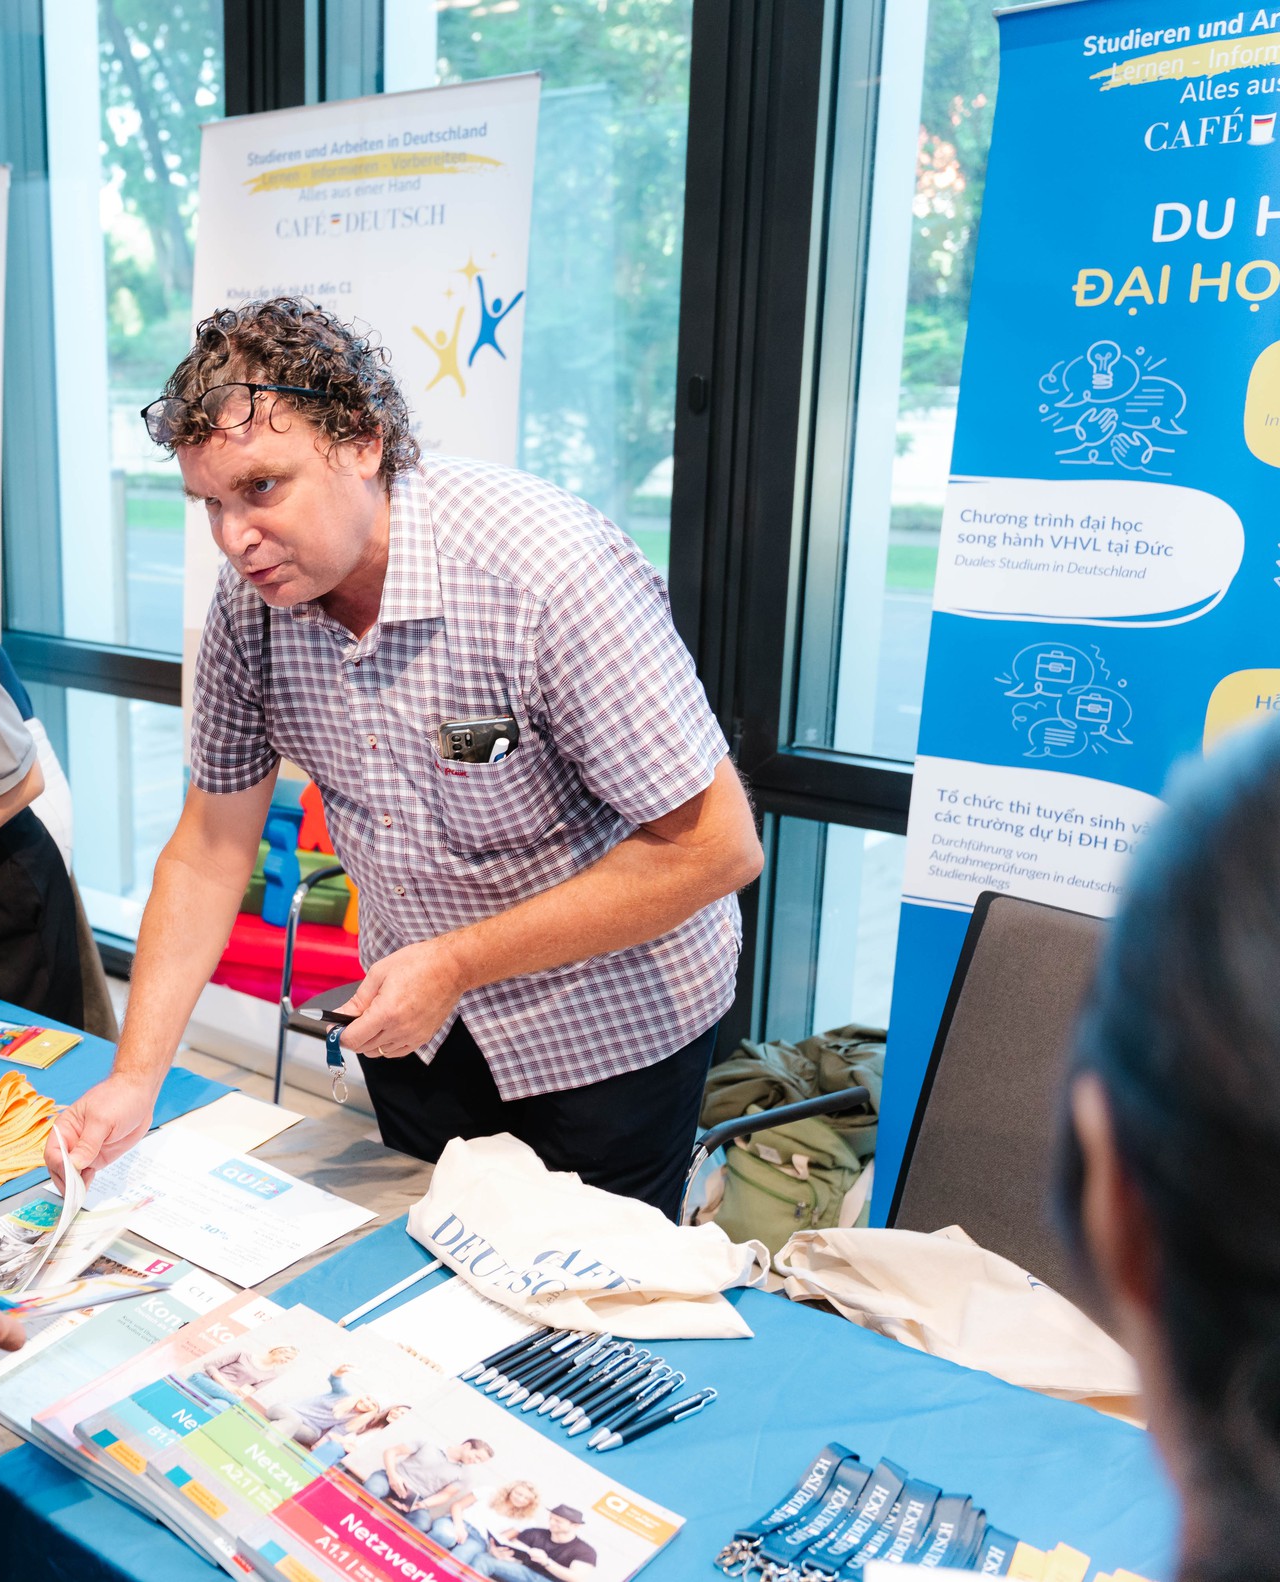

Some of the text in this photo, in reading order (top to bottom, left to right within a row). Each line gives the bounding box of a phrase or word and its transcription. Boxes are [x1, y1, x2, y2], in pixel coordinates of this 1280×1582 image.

[1083, 26, 1190, 56] Studieren
[1198, 12, 1244, 39] und
[1111, 57, 1184, 83] Lernen
[1180, 80, 1239, 104] Alles
[247, 122, 487, 167] Studieren und Arbeiten in Deutschland
[1144, 107, 1244, 151] CAFÉ
[261, 169, 300, 186] Lernen
[311, 162, 379, 180] Informieren
[392, 150, 467, 170] Vorbereiten
[298, 177, 421, 202] Alles aus einer Hand
[276, 204, 446, 239] CAFÉ DEUTSCH
[1152, 197, 1236, 243] DU
[1072, 260, 1280, 316] ĐẠI HỌ
[960, 509, 1143, 535] Chương trình đại học
[957, 532, 1174, 558] song hành VHVL tại Đức
[954, 554, 1147, 580] Duales Studium in Deutschland
[937, 788, 959, 804] Tổ
[963, 793, 1004, 812] chức
[1009, 800, 1031, 816] thi
[1036, 806, 1085, 825] tuyển
[1090, 814, 1126, 832] sinh
[934, 809, 961, 826] các
[966, 813, 1024, 839] trường
[1029, 824, 1053, 841] dự
[1058, 829, 1073, 847] bị
[1078, 833, 1108, 851] ĐH
[931, 834, 1038, 863] Durchführung von
[928, 865, 1011, 890] Studienkollegs
[929, 850, 1051, 882] Aufnahmeprüfungen
[1053, 871, 1064, 884] in
[151, 1261, 167, 1274] 5
[147, 1425, 176, 1448] B1.1
[220, 1463, 252, 1489] A2.1
[790, 1458, 832, 1512] DEUTSCH
[812, 1484, 852, 1534] DEUTSCH
[850, 1484, 890, 1540] DEUTSCH
[890, 1500, 925, 1559] DEUTSCH
[315, 1536, 352, 1563] A1.1
